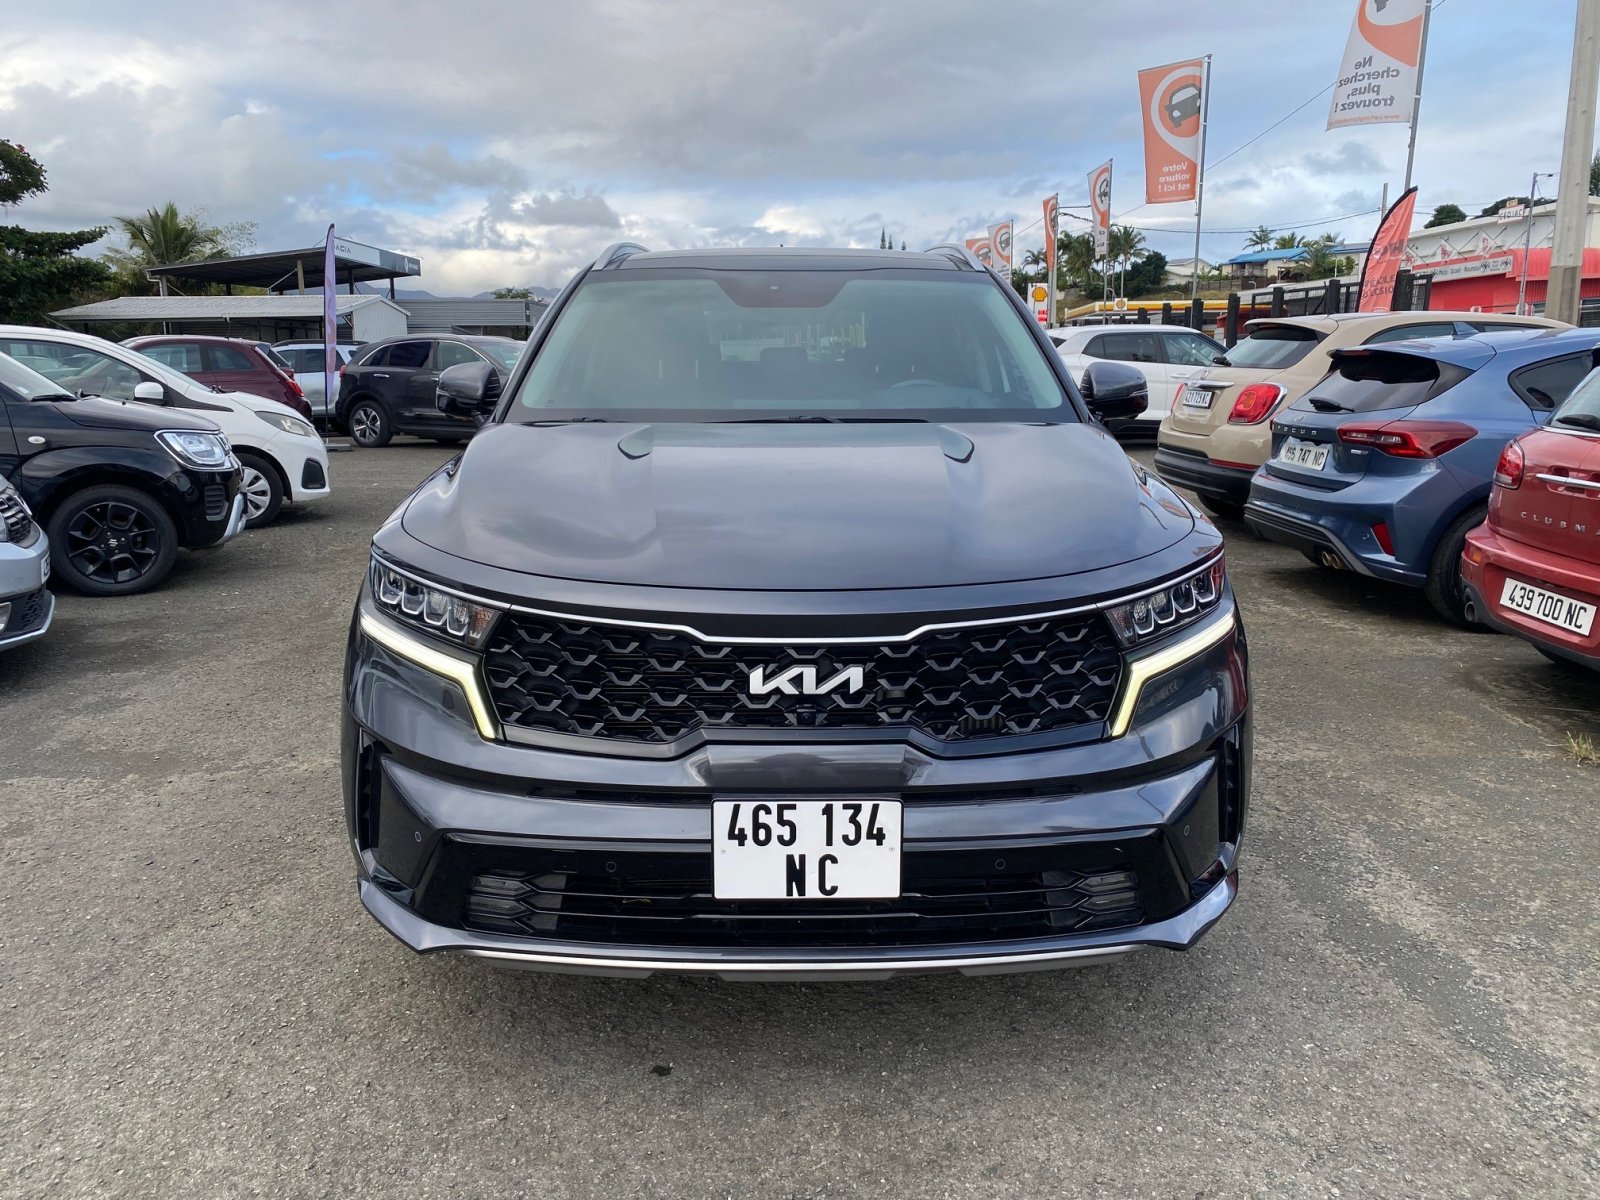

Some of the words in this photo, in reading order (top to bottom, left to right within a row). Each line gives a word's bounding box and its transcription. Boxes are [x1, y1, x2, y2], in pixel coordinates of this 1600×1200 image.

[1297, 448, 1312, 462] 747
[1312, 451, 1325, 466] NC
[1508, 584, 1535, 611] 439
[1537, 592, 1564, 621] 700
[1564, 602, 1587, 629] NC
[750, 665, 864, 695] KIA
[727, 803, 798, 847] 465
[821, 803, 887, 847] 134
